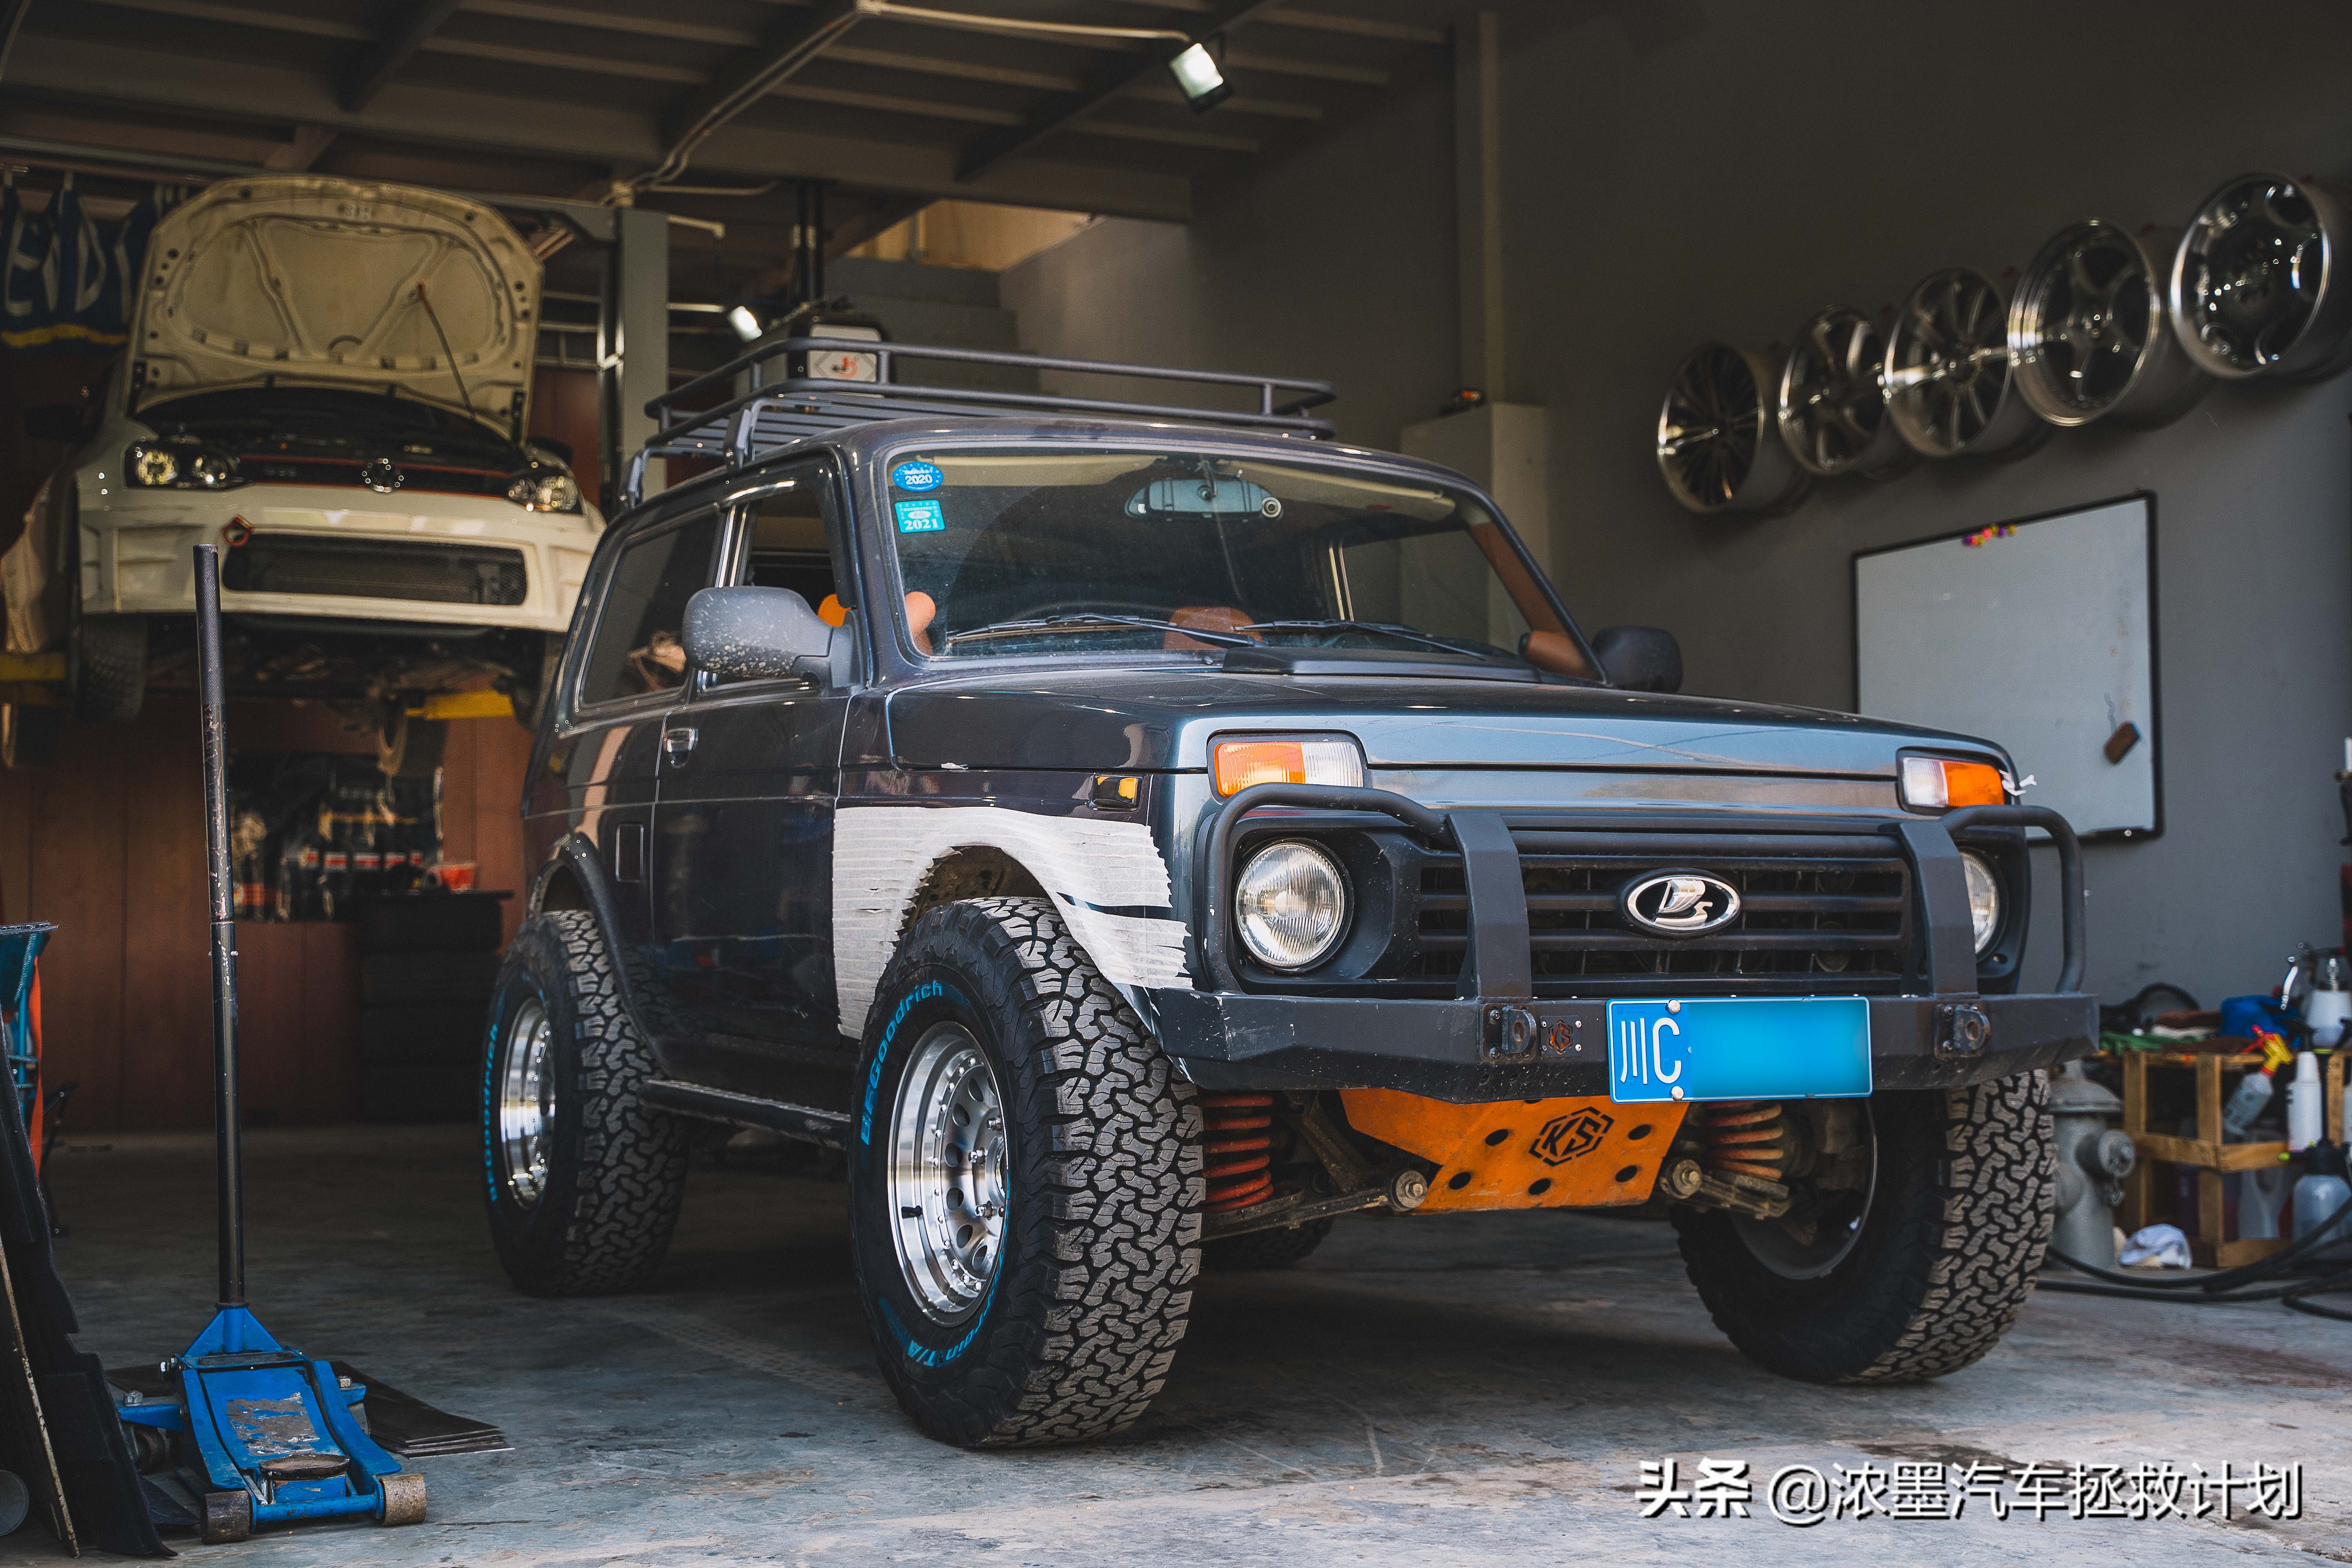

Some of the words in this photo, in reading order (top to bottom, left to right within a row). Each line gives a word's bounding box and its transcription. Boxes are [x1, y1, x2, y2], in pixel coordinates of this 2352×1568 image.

[905, 474, 933, 485] 2020
[904, 519, 939, 530] 2021
[1550, 1022, 1571, 1050] KS
[861, 980, 943, 1145] BFGoodrich
[1541, 1116, 1602, 1157] KS
